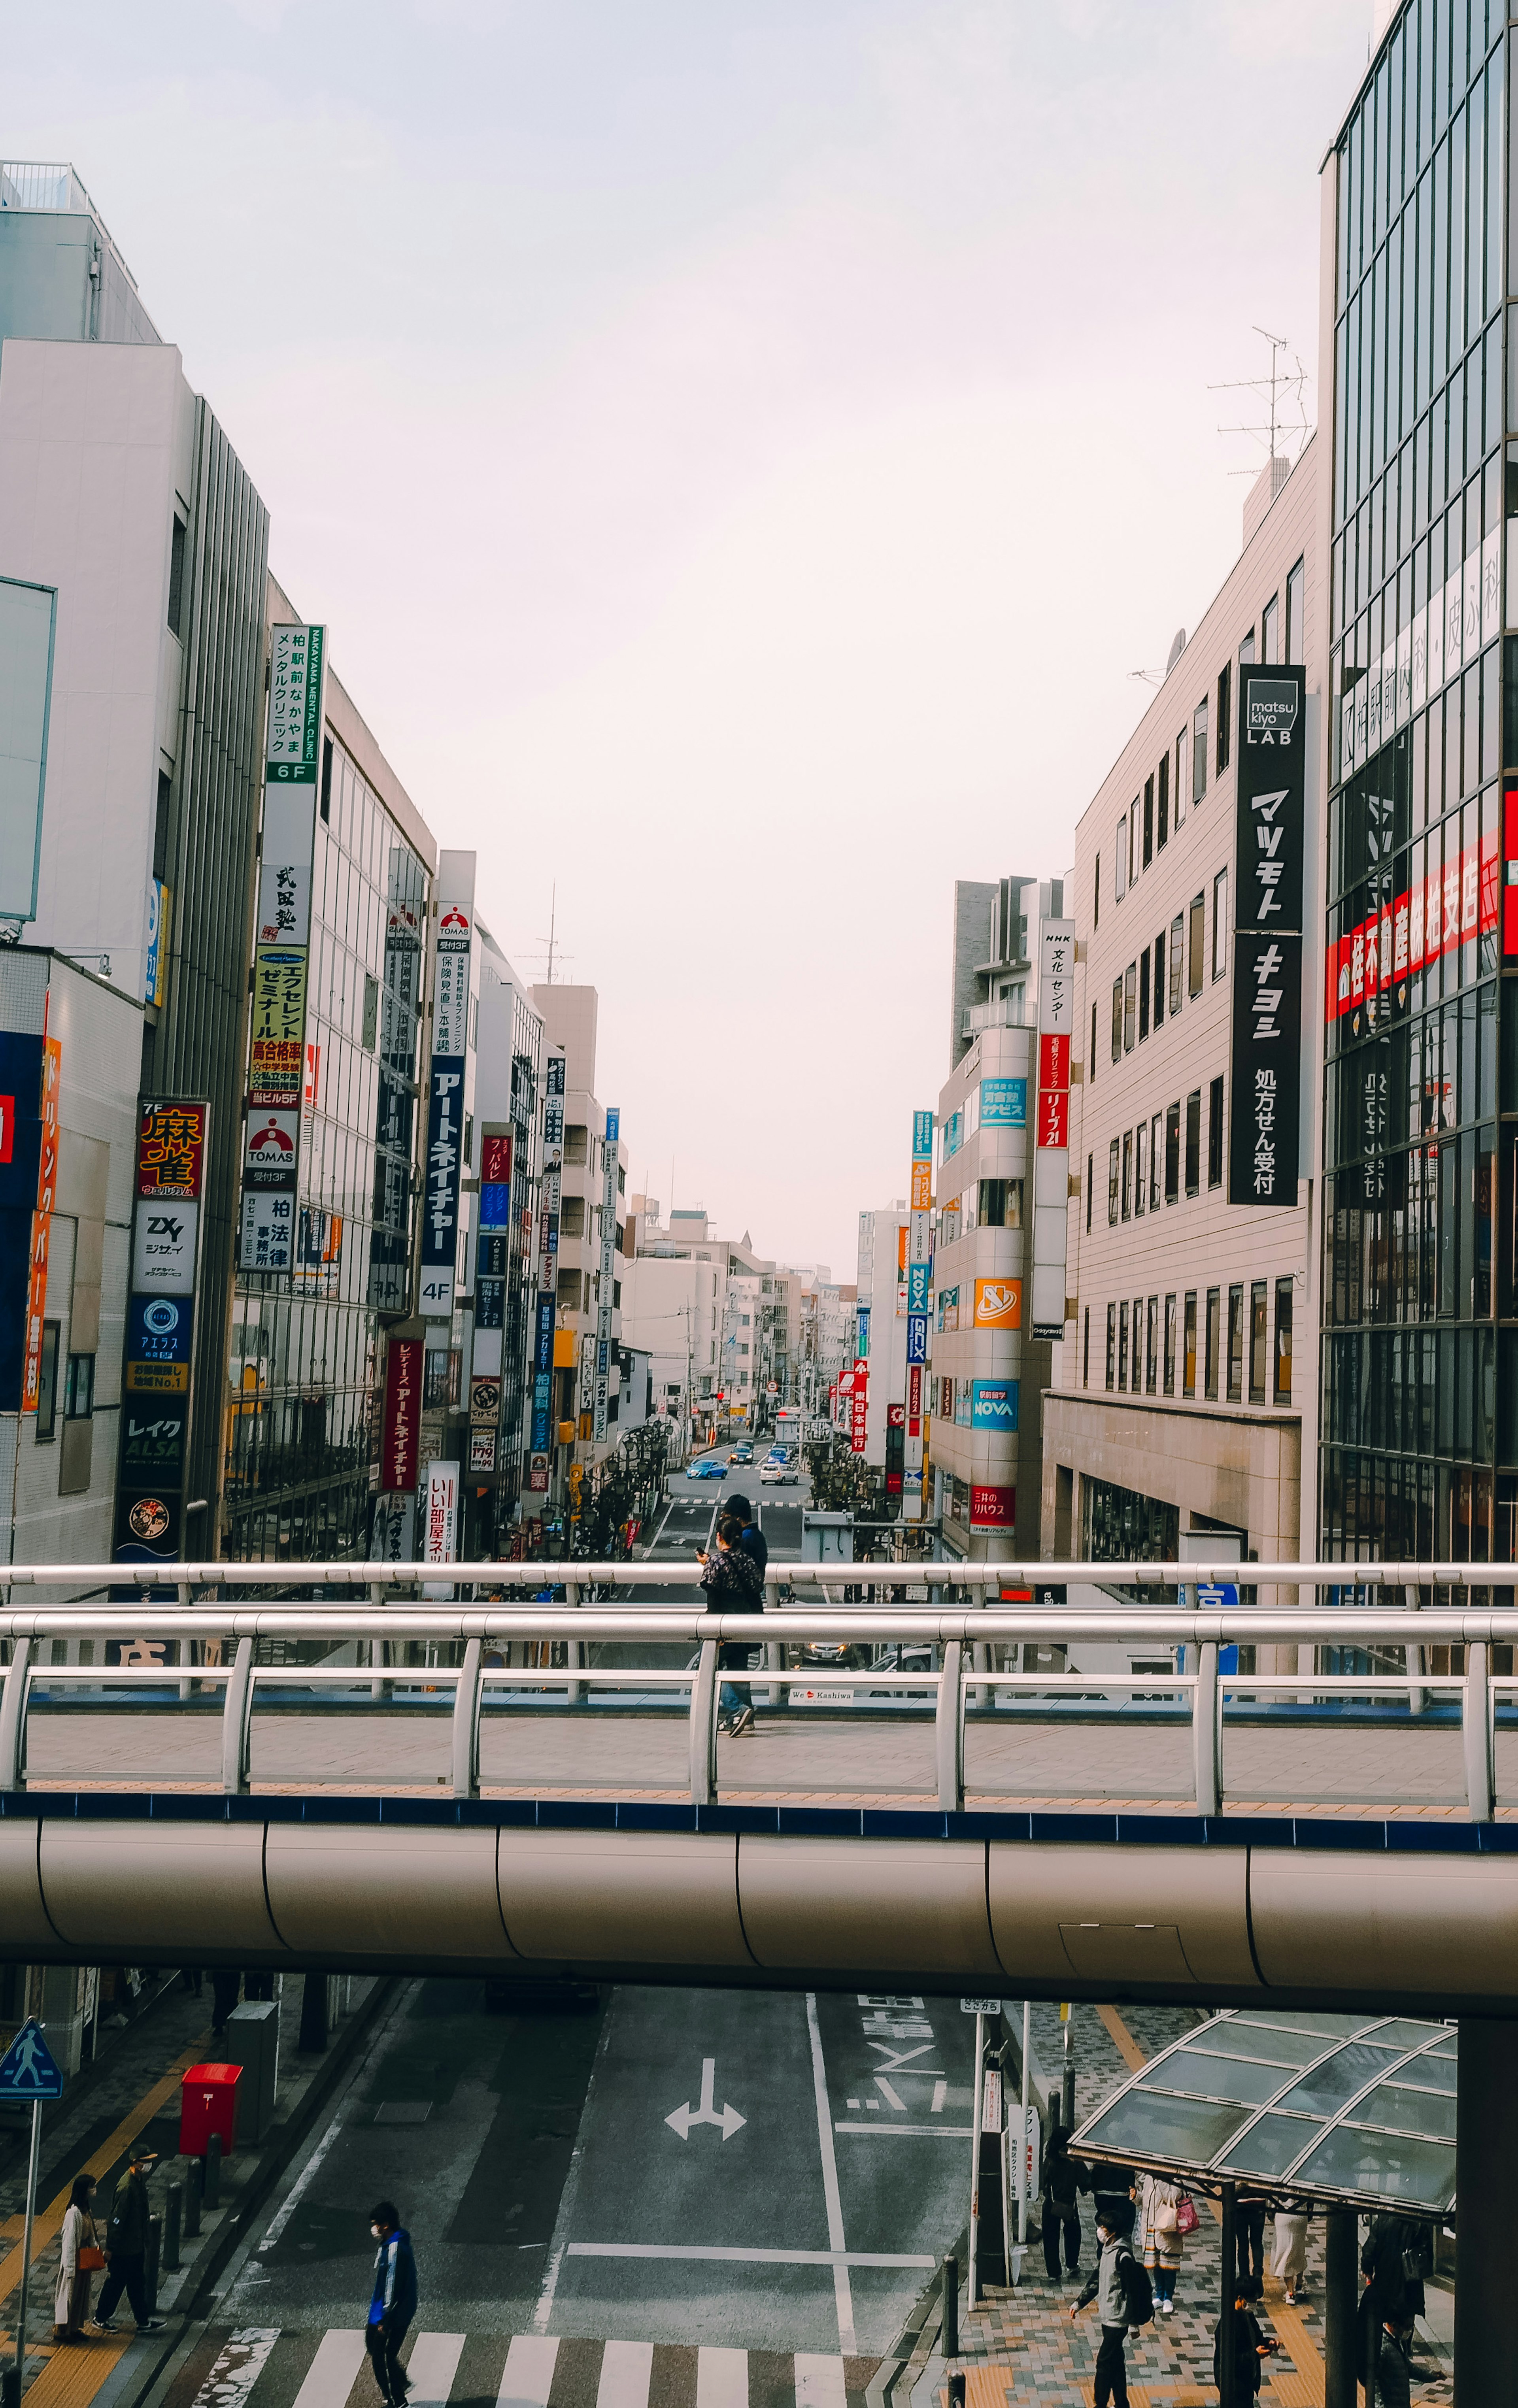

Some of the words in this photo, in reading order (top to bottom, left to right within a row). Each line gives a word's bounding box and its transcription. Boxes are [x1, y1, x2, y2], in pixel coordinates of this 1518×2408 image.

[310, 630, 320, 684] NAKAYAMA
[272, 634, 289, 752] メンタルクリニック
[288, 634, 305, 753] 柏駅前なかやま
[307, 687, 317, 726] MENTAL
[1252, 702, 1293, 713] matsu
[1251, 713, 1277, 728] kiyo
[305, 728, 315, 759] CLINIC
[1247, 730, 1291, 745] LAB
[278, 765, 306, 778] 6F
[440, 927, 468, 936] TOMAS
[440, 941, 467, 950] 受付3F
[1052, 949, 1065, 1021] 文化センター
[257, 969, 282, 1039] ゼミナール
[281, 967, 302, 1039] エクセレント
[438, 956, 452, 1039] 保険見直し本舗
[253, 1040, 302, 1062] 高合格率
[1051, 1036, 1060, 1088] 毛髪クリニック
[143, 1103, 163, 1114] 7F
[252, 1093, 297, 1104] 当ビル5F
[1046, 1093, 1060, 1145] リーブ21
[1253, 1068, 1277, 1195] 処方せん受付
[140, 1109, 203, 1187] 麻雀
[248, 1151, 293, 1163] TOMAS
[428, 1073, 460, 1249] アートネイチャー
[253, 1172, 286, 1181] 受付3F
[147, 1217, 185, 1243] ZXY
[145, 1244, 184, 1255] ジザイ
[422, 1283, 451, 1300] 4F
[913, 1268, 925, 1309] NOVA
[141, 1336, 178, 1349] アエラス
[914, 1318, 925, 1360] GCX
[974, 1402, 1013, 1416] NOVA
[128, 1419, 181, 1438] レイク
[853, 1391, 865, 1448] 東日本銀行
[126, 1440, 180, 1457] ALSA
[531, 1472, 546, 1488] 薬
[975, 1493, 997, 1502] 三井の
[429, 1478, 446, 1561] いい部屋ネッ
[974, 1504, 1004, 1515] リハウス
[965, 2002, 997, 2011] ここから
